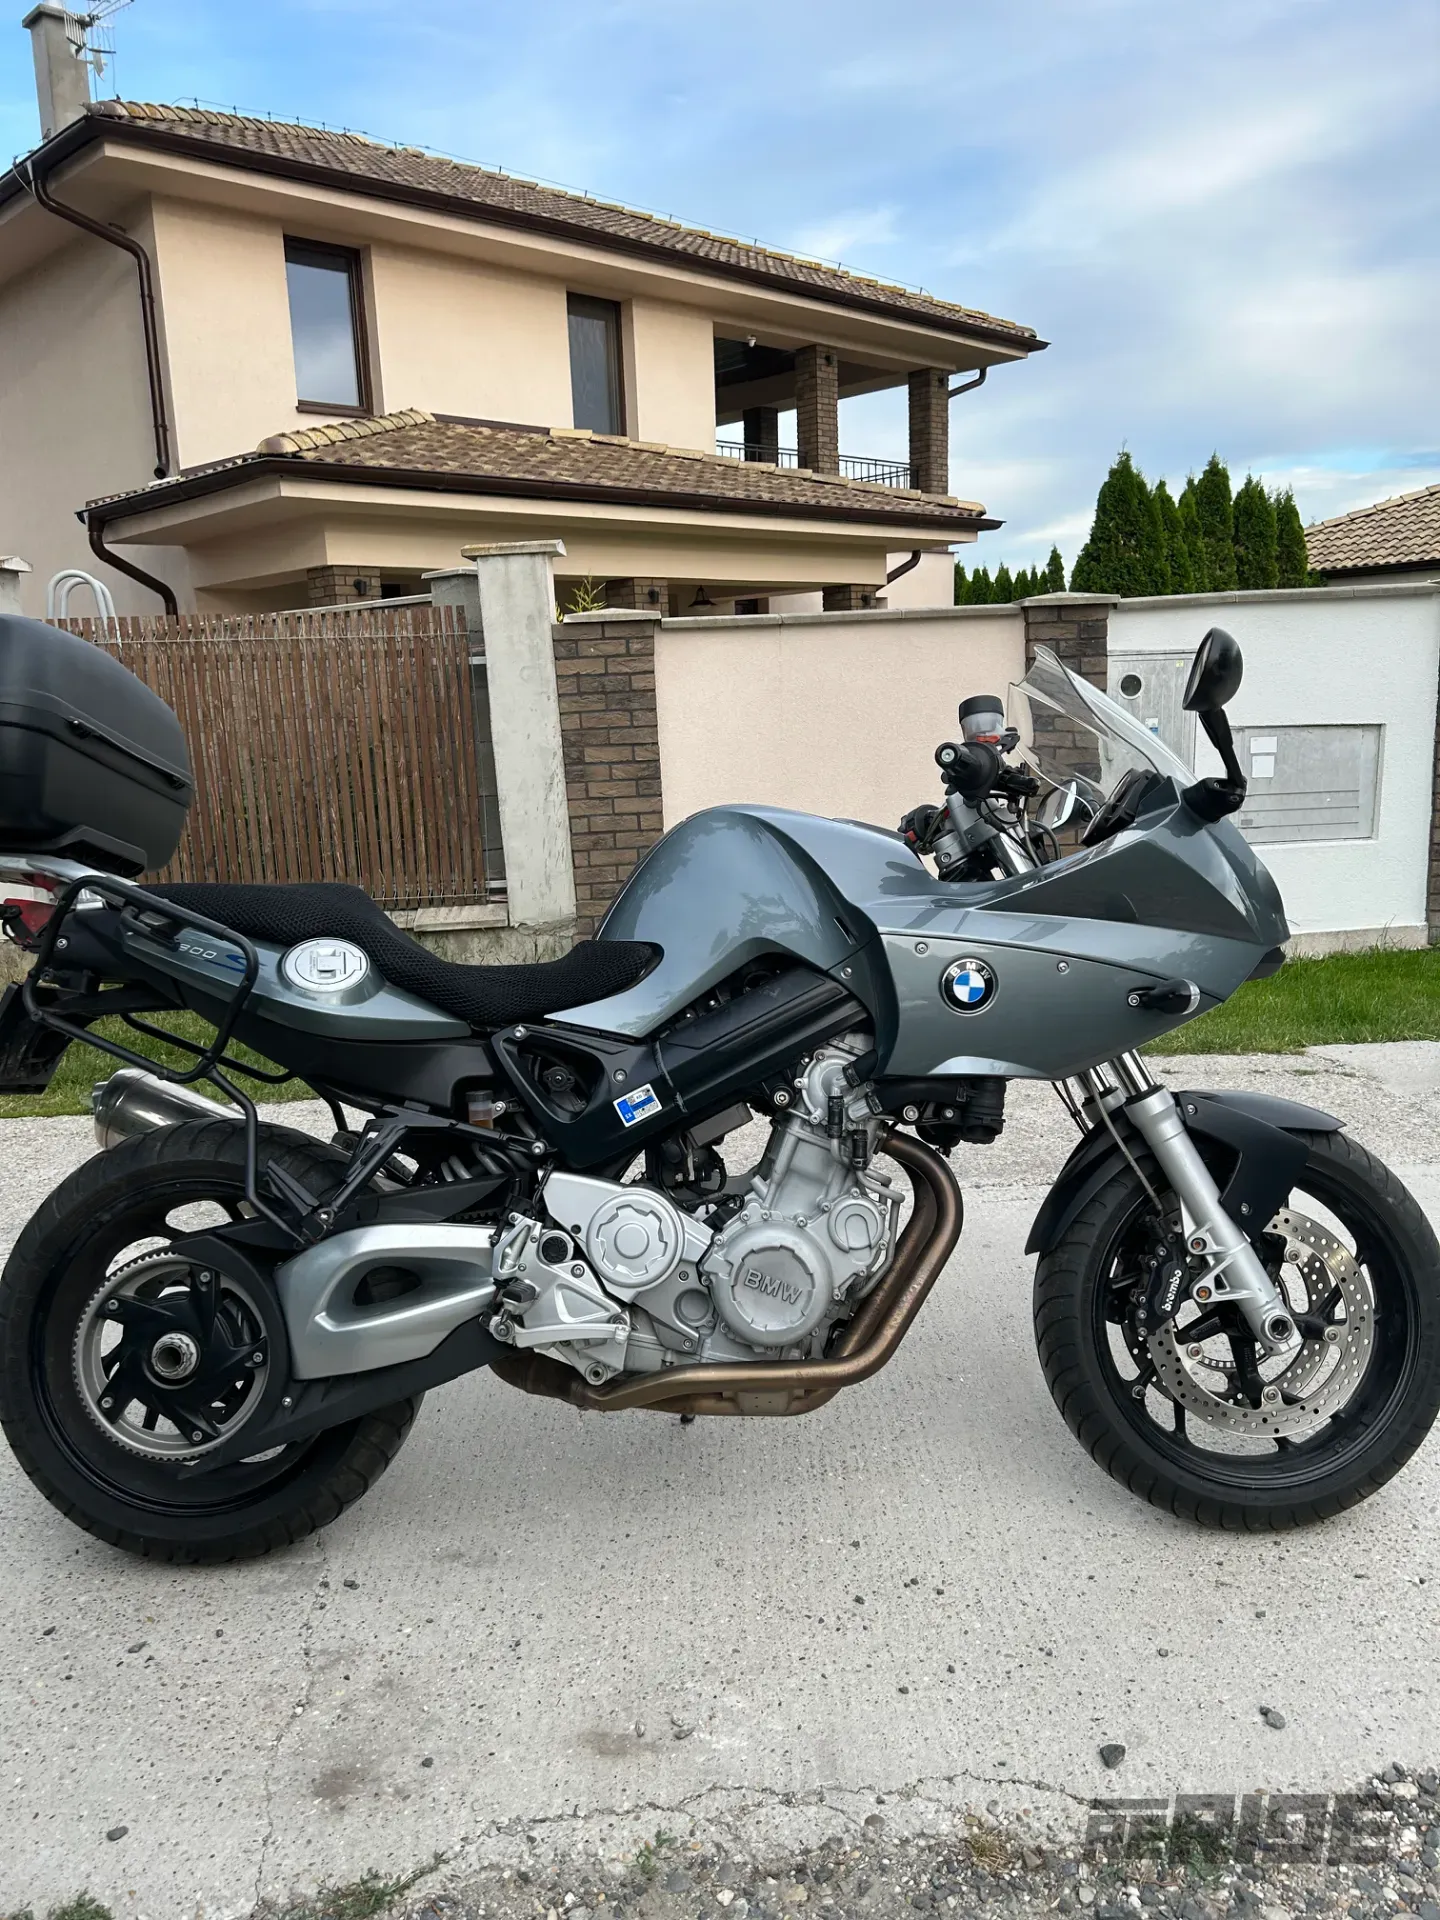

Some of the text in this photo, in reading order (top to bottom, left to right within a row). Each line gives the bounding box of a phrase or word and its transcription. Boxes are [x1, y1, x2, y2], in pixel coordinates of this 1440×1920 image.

[949, 961, 991, 980] BMW
[744, 1268, 802, 1305] BMW
[1161, 1269, 1182, 1311] brembo
